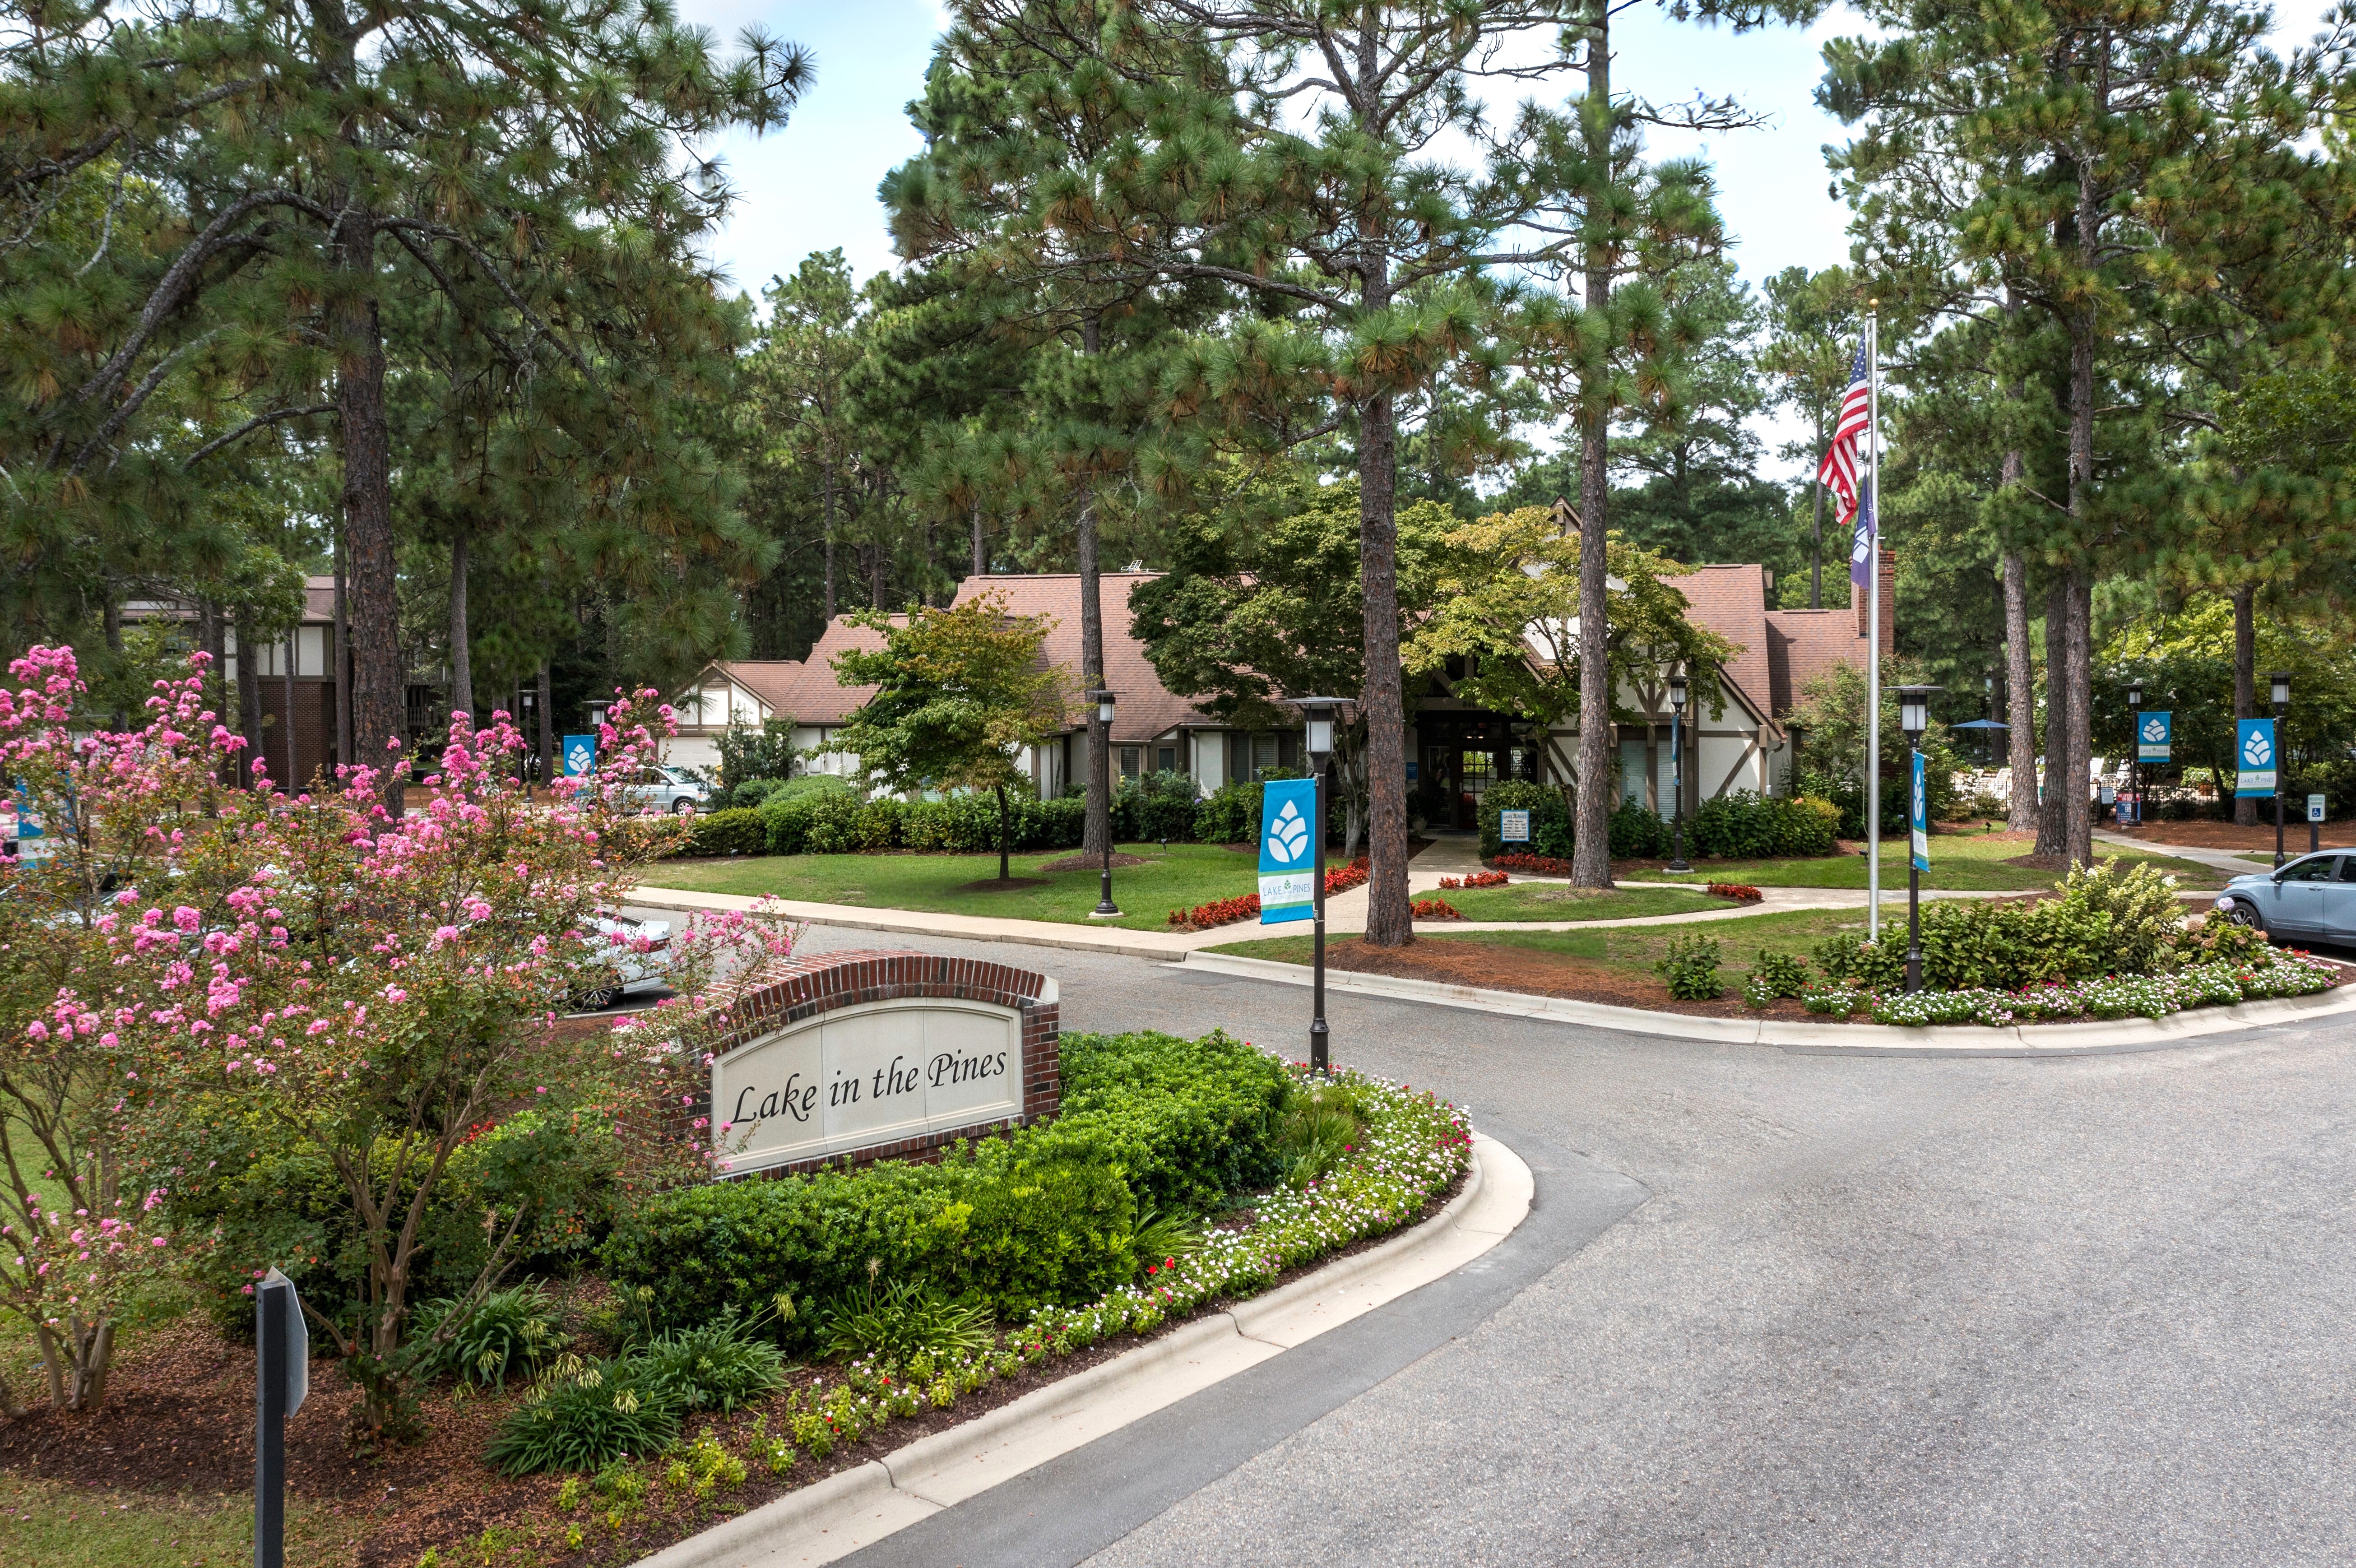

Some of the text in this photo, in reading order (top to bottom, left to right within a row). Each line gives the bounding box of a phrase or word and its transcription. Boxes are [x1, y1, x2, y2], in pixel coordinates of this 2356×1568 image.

[1263, 886, 1282, 896] LAKE
[1293, 883, 1311, 893] PINES
[731, 1048, 1007, 1124] Lake in the Pines
